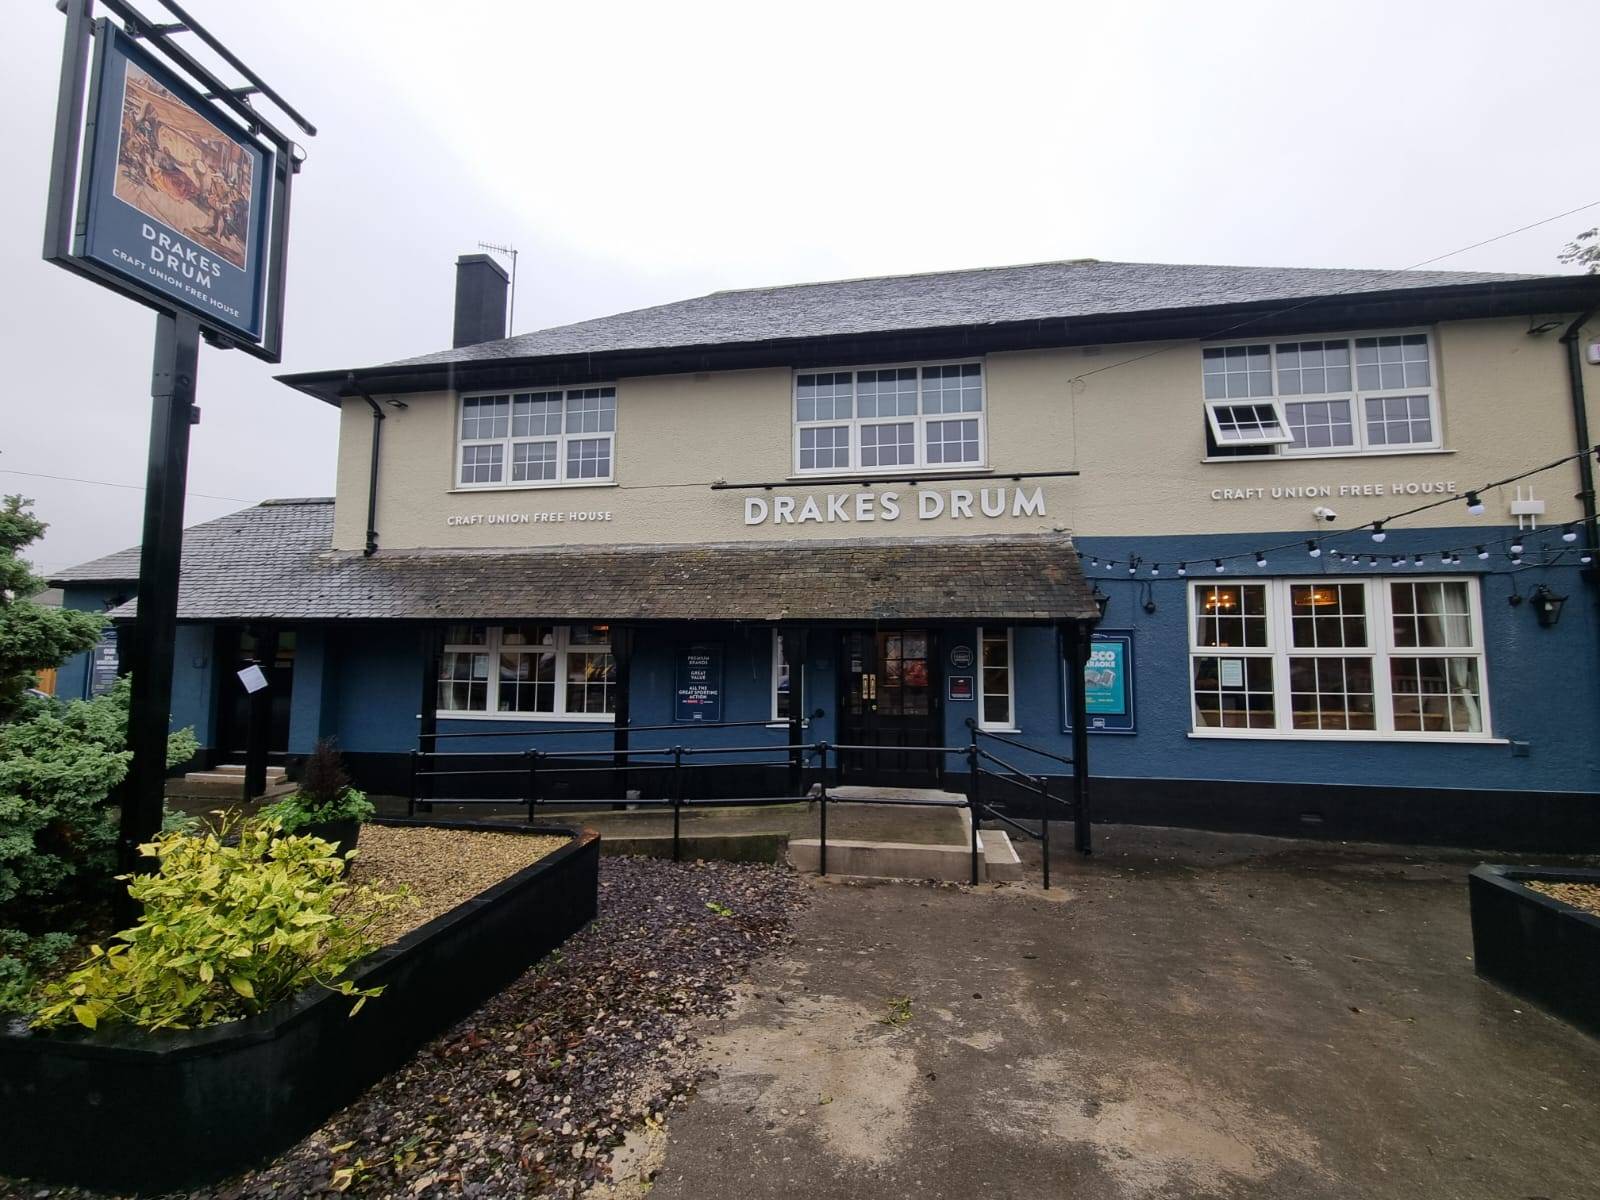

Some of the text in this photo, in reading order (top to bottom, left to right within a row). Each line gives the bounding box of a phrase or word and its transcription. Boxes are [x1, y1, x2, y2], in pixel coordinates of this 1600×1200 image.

[142, 223, 221, 277] DRAKES
[151, 246, 211, 288] DRUM
[112, 248, 240, 318] CRAFT UNION FREE HOUSE
[744, 487, 1046, 525] DRAKES DRUM
[1211, 482, 1457, 500] CRAFT UNION FREE HOUSE
[448, 511, 612, 525] CRAFT UNION FREE HOUSE
[1091, 651, 1115, 660] SCO
